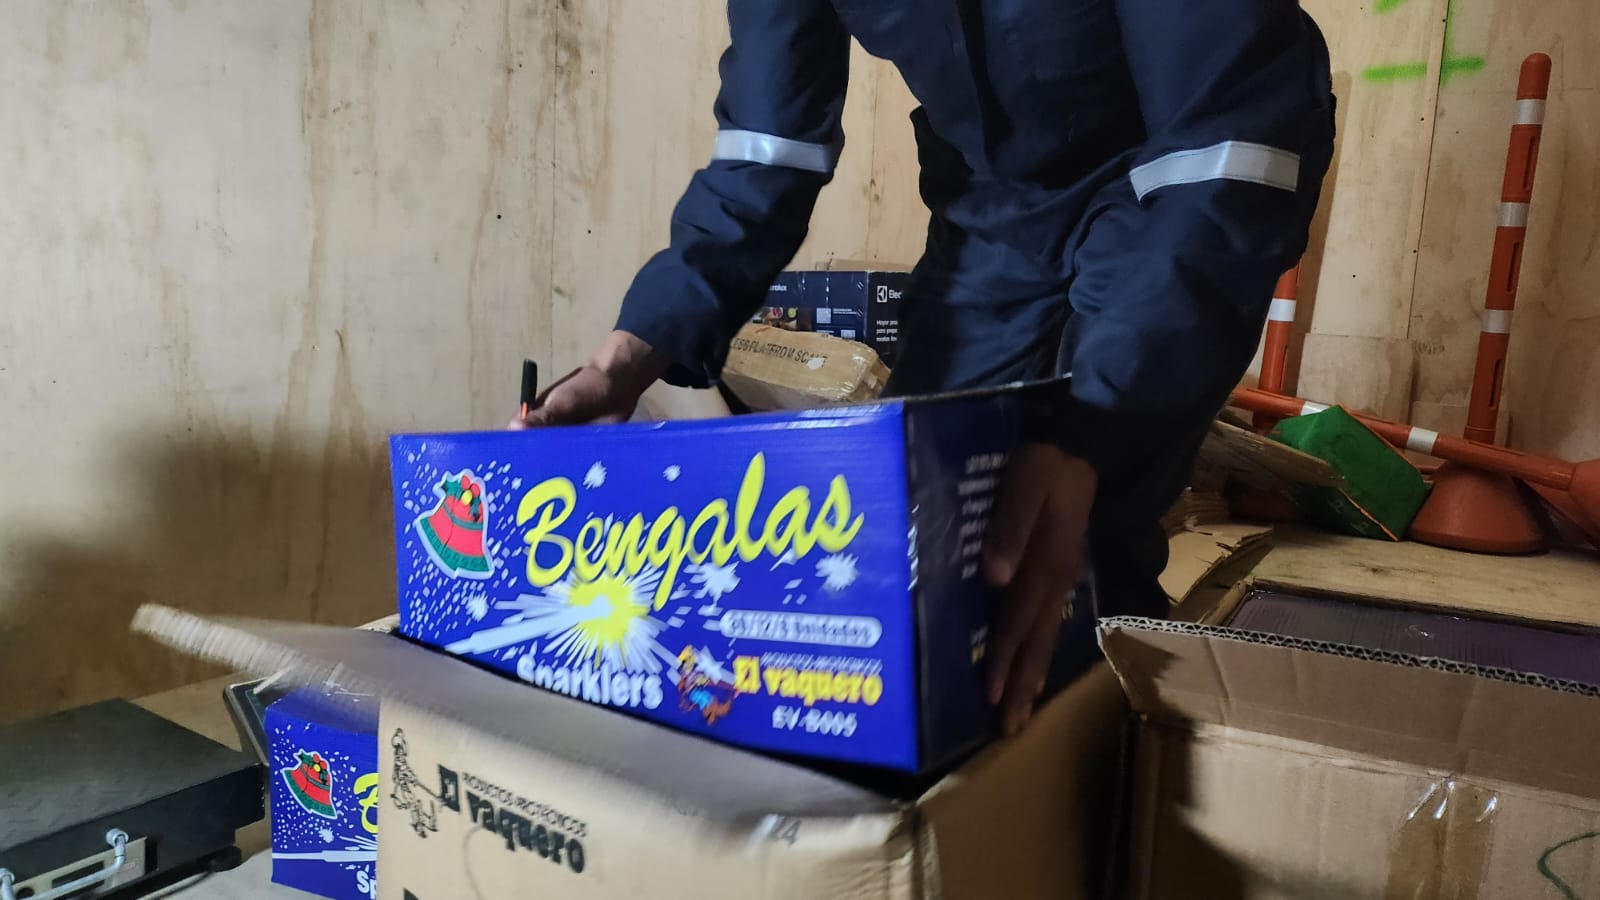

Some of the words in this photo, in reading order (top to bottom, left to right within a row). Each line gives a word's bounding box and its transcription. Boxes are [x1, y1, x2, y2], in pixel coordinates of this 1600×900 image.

[517, 451, 865, 612] Bengalas
[763, 667, 883, 706] vaquero
[466, 790, 585, 874] vaquero
